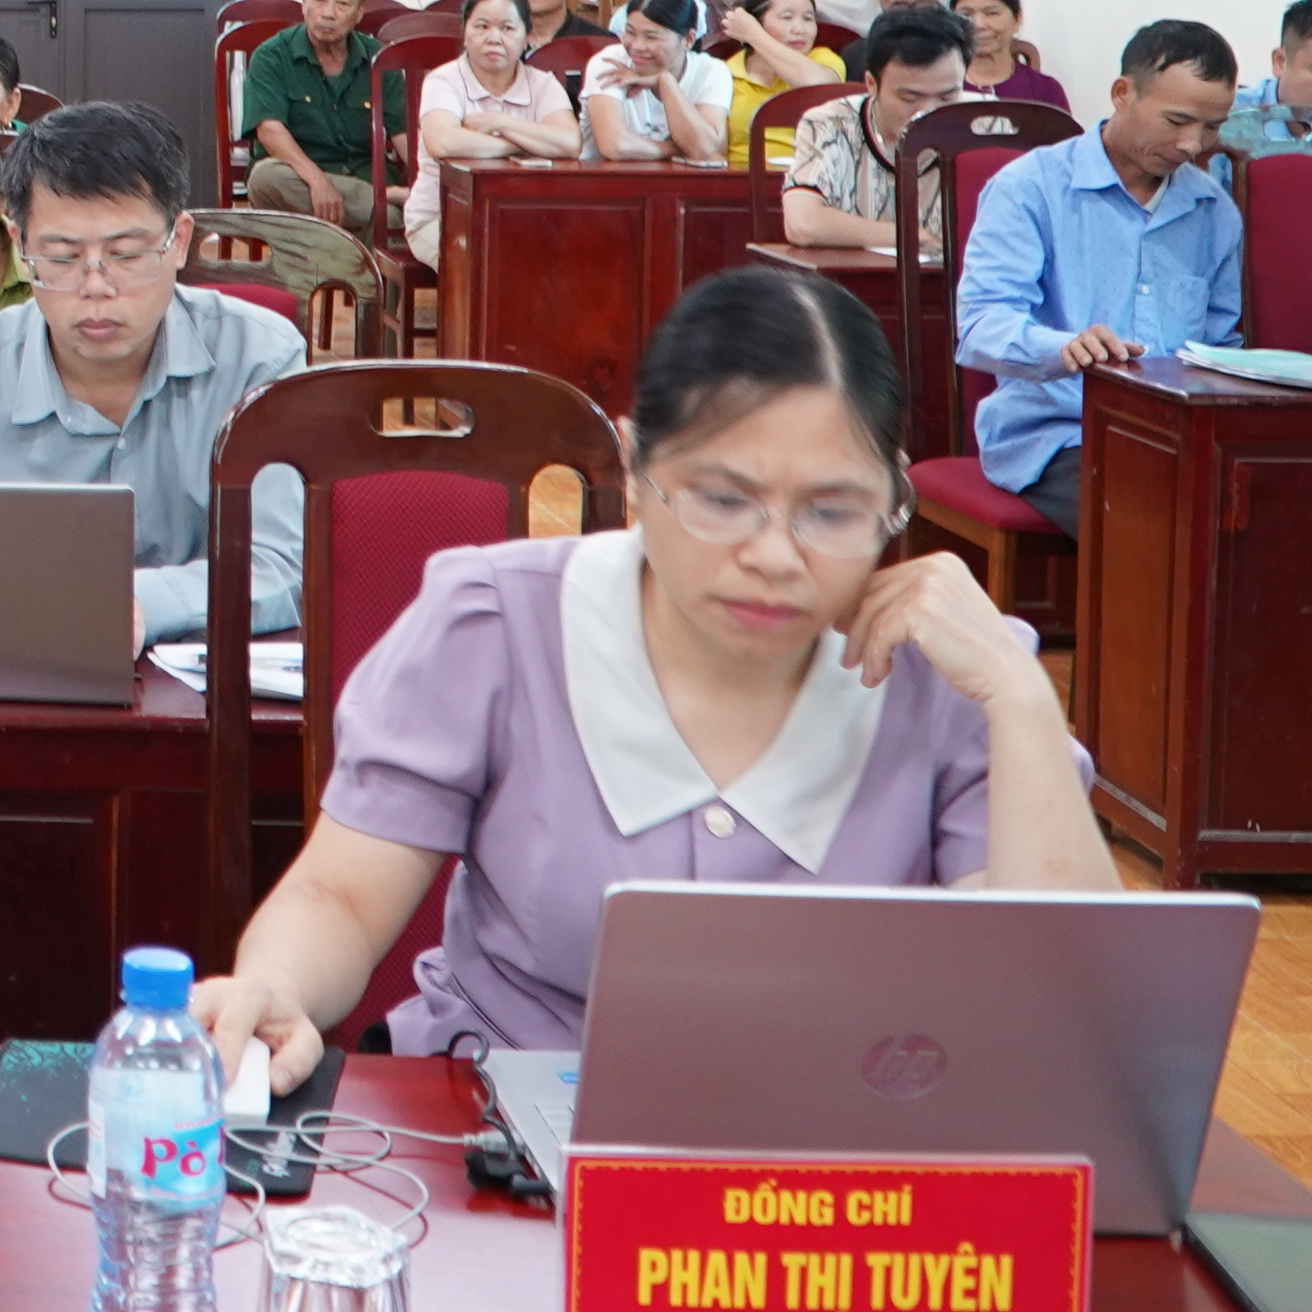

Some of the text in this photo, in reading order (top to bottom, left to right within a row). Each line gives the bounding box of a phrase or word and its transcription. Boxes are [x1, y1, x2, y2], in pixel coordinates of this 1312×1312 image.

[140, 1136, 207, 1180] Pò
[723, 1179, 912, 1226] ĐỒNG CHÍ
[637, 1247, 768, 1310] PHAN
[865, 1241, 1013, 1312] TUYÊN
